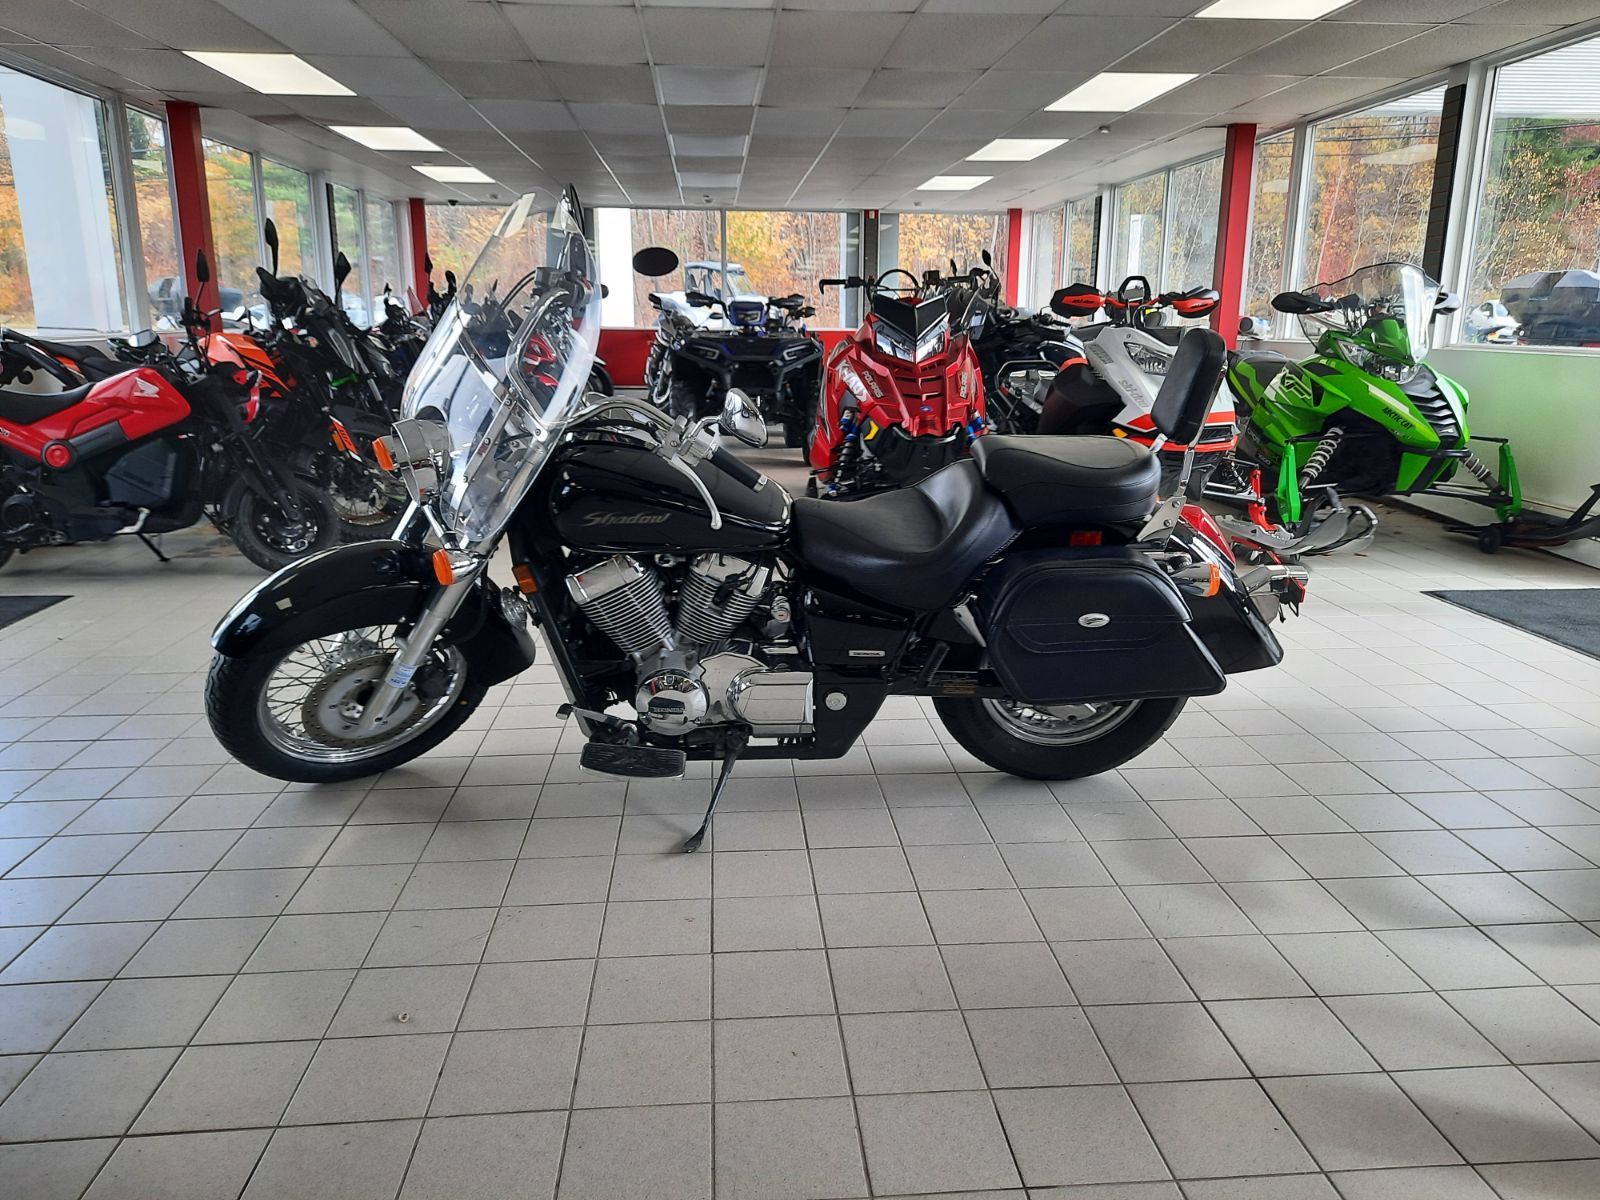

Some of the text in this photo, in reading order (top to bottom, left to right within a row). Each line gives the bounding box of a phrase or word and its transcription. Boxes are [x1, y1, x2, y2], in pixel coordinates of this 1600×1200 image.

[862, 370, 884, 398] POLARIS
[1382, 407, 1402, 422] ARCTIC
[581, 511, 671, 527] Shadow
